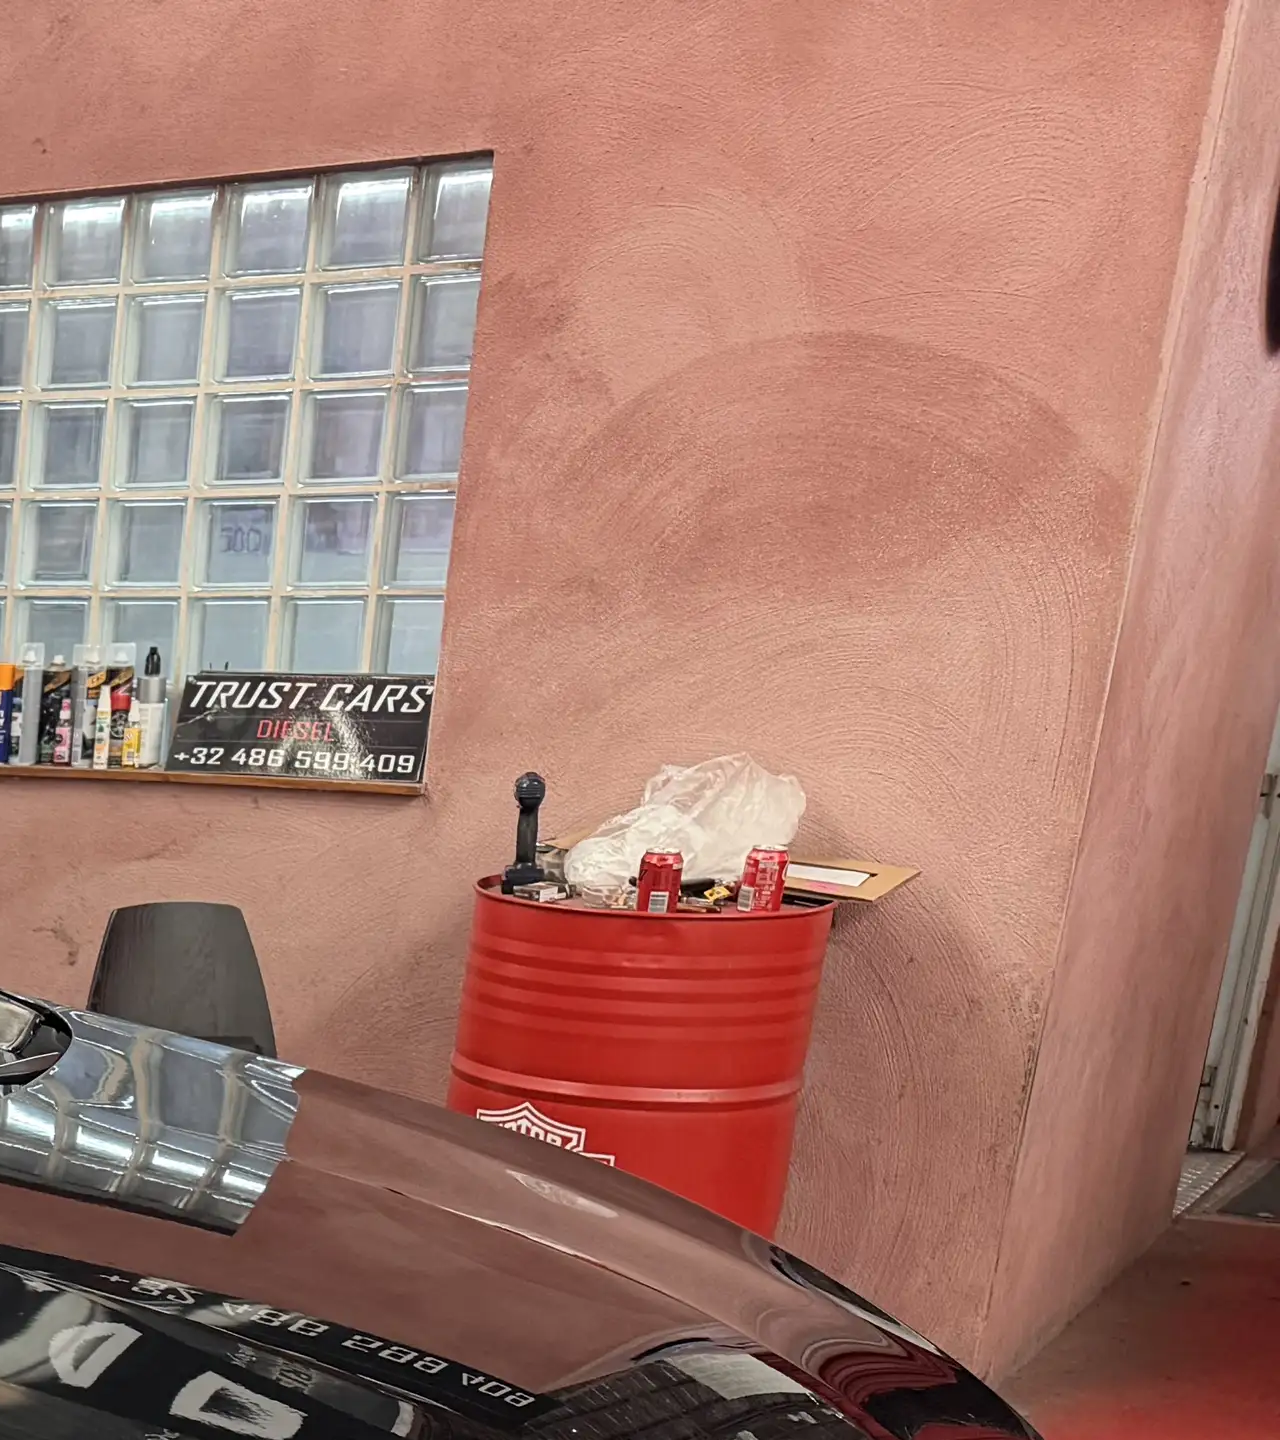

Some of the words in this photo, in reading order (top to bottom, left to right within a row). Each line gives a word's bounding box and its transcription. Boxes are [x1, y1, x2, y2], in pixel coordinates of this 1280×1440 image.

[189, 681, 317, 710] TRUST
[319, 684, 434, 713] CARS
[256, 719, 336, 743] DIESEL
[173, 747, 225, 766] +32
[230, 748, 286, 767] 486
[294, 751, 351, 771] 599
[359, 754, 416, 774] 409
